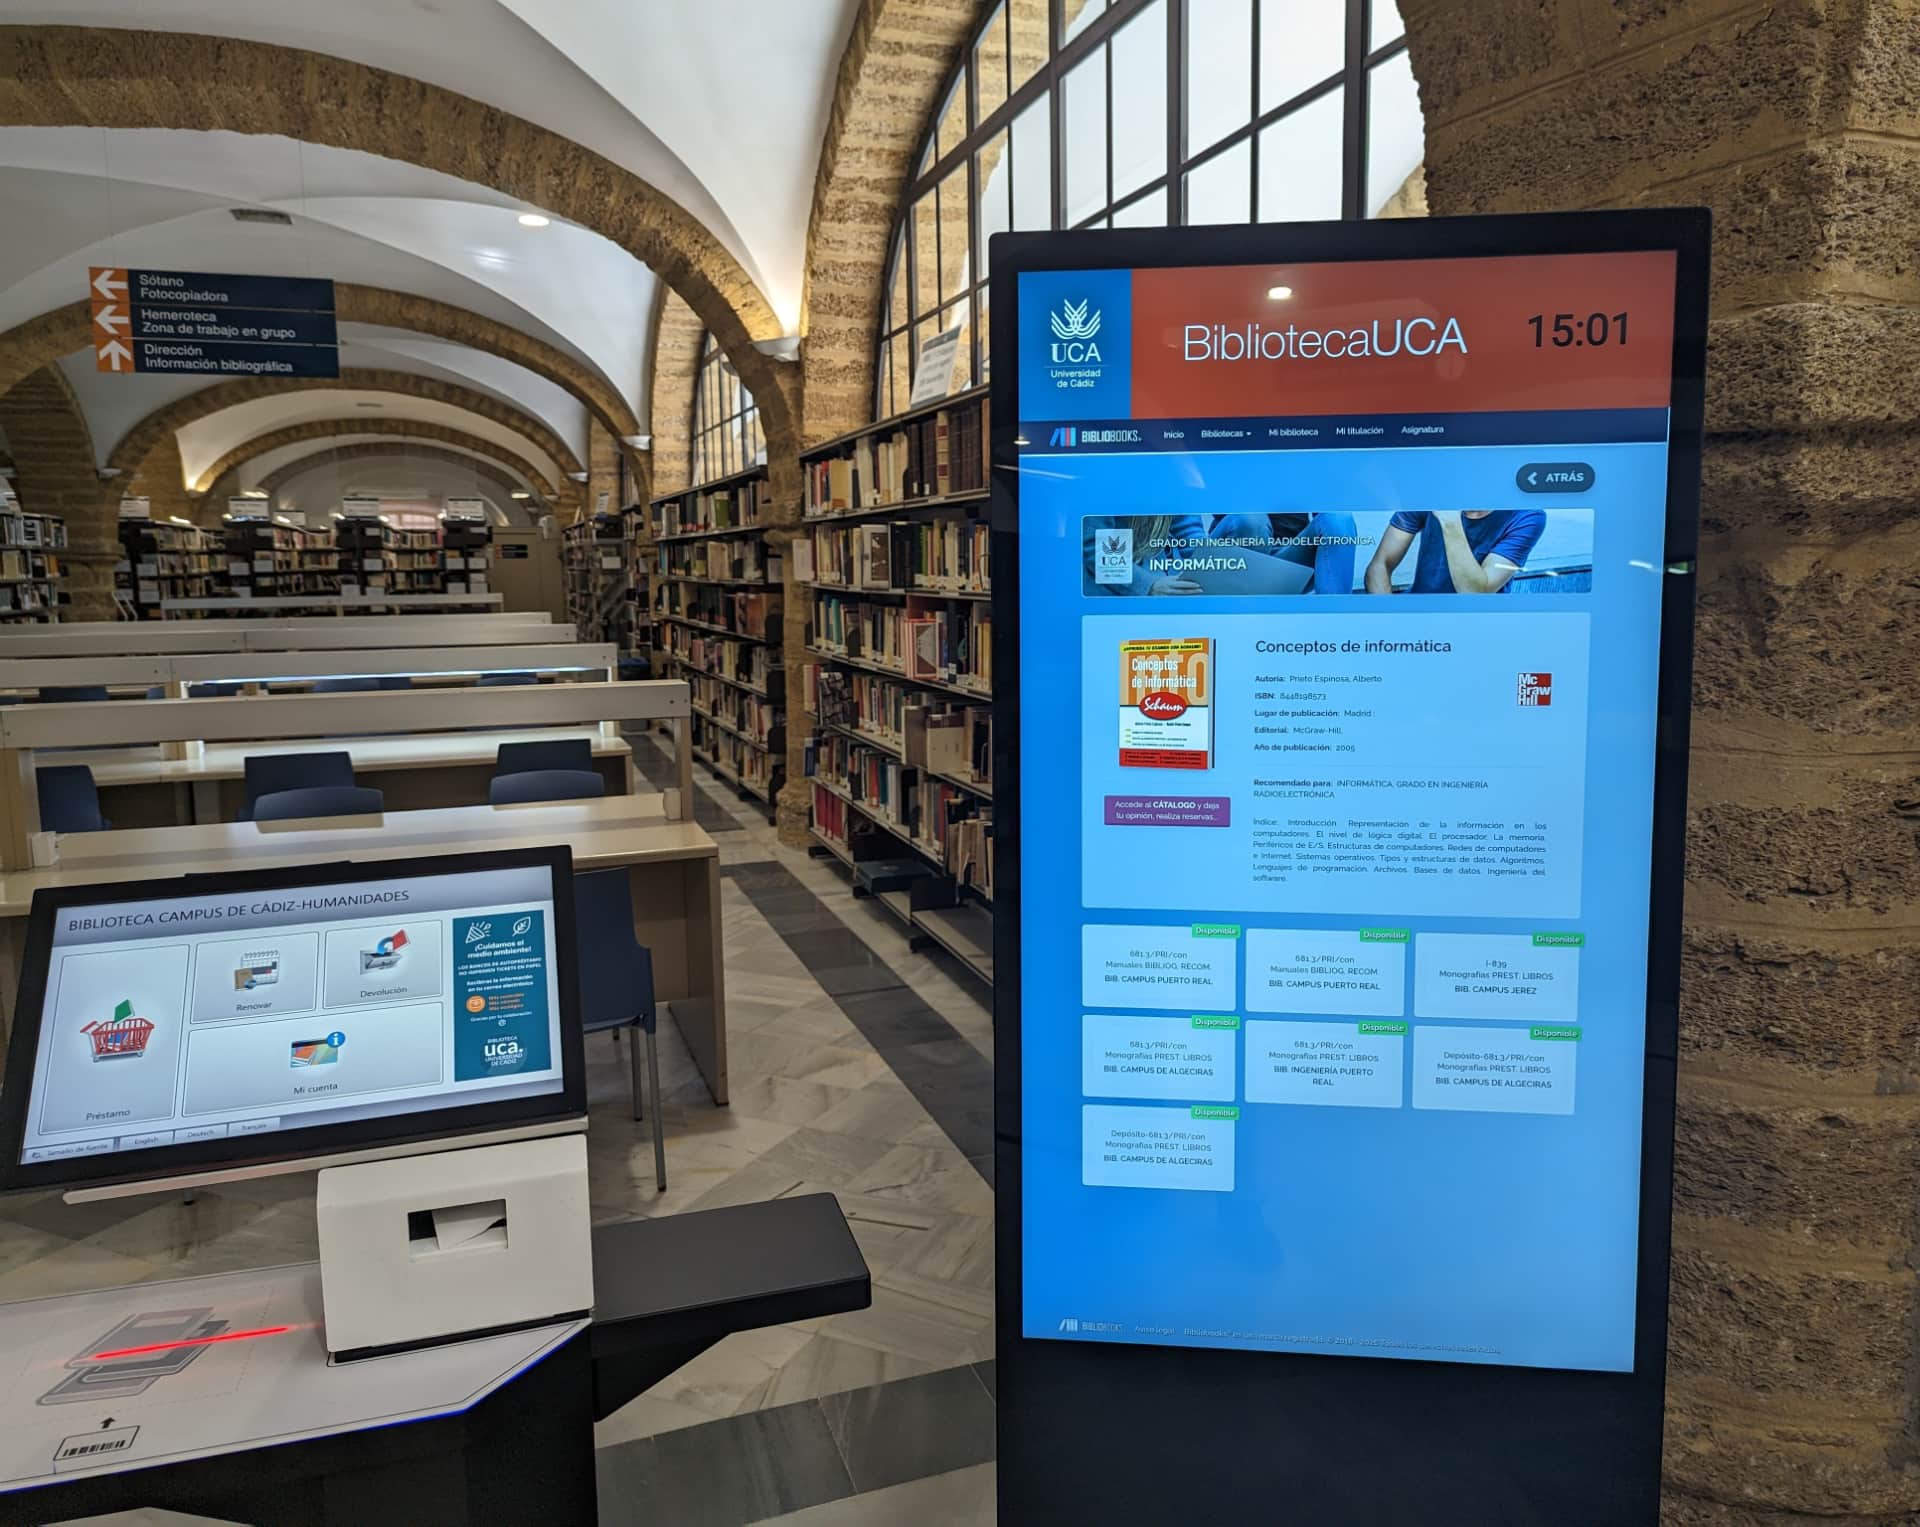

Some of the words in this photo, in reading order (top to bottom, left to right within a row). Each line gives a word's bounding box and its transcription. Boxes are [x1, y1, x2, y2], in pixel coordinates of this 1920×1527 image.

[140, 274, 184, 287] Sótano
[141, 288, 228, 303] Fotocopiadora
[141, 309, 217, 322] Hemeroteca
[143, 322, 174, 333] Zona
[178, 323, 194, 334] de
[197, 324, 239, 338] trabajo
[242, 329, 258, 337] en
[261, 329, 296, 340] grupo
[1528, 312, 1627, 347] 15:01
[1184, 317, 1468, 361] BibliotecaUCA
[144, 343, 202, 356] Dirección
[1050, 343, 1101, 363] UCA
[146, 357, 218, 370] Información
[221, 359, 293, 373] bibliográfica
[1050, 368, 1101, 378] Universidad
[1057, 378, 1068, 388] de
[1070, 377, 1094, 388] Cádiz
[1163, 430, 1184, 440] Inicio
[1201, 429, 1244, 438] Bibliotecas
[1269, 428, 1277, 437] Mi
[1278, 427, 1319, 437] biblioteca
[1336, 426, 1345, 436] Mi
[1347, 425, 1384, 436] titulación
[1401, 425, 1444, 435] Asignatura
[1546, 471, 1584, 483] ATRÁS
[1150, 538, 1187, 548] GRADO
[1189, 538, 1204, 547] EN
[1206, 535, 1265, 547] INGENIERÍA
[1268, 534, 1375, 546] RADIOELECTRÓNICA
[1150, 555, 1246, 571] INFORMÁTICA
[1256, 640, 1336, 656] Conceptos
[1341, 640, 1360, 652] de
[1365, 640, 1451, 652] informática
[1518, 673, 1537, 685] Mc
[1518, 685, 1551, 696] Graw
[1254, 710, 1277, 718] Lugar
[1115, 800, 1143, 808] Accede
[1153, 800, 1196, 809] CÁTALOGO
[69, 913, 154, 931] BIBLIOTECA
[159, 907, 222, 923] CAMPUS
[227, 906, 246, 917] DE
[251, 890, 409, 915] CÁDIZ-HUMANIDADES
[1536, 934, 1580, 944] Disponible
[1522, 971, 1553, 980] LIBROS
[360, 986, 407, 998] Devolución
[236, 1001, 272, 1012] Renovar
[1534, 1028, 1577, 1038] Disponible
[484, 1042, 523, 1057] uca.
[1169, 1068, 1213, 1076] ALGECIRAS
[1340, 1068, 1373, 1076] PUERTO
[1520, 1065, 1551, 1074] LIBROS
[1453, 1078, 1489, 1086] CAMPUS
[1505, 1080, 1552, 1088] ALGECIRAS
[294, 1086, 305, 1095] Mi
[307, 1083, 338, 1093] cuenta
[86, 1108, 130, 1121] Préstamo
[1183, 1144, 1212, 1152] LIBROS
